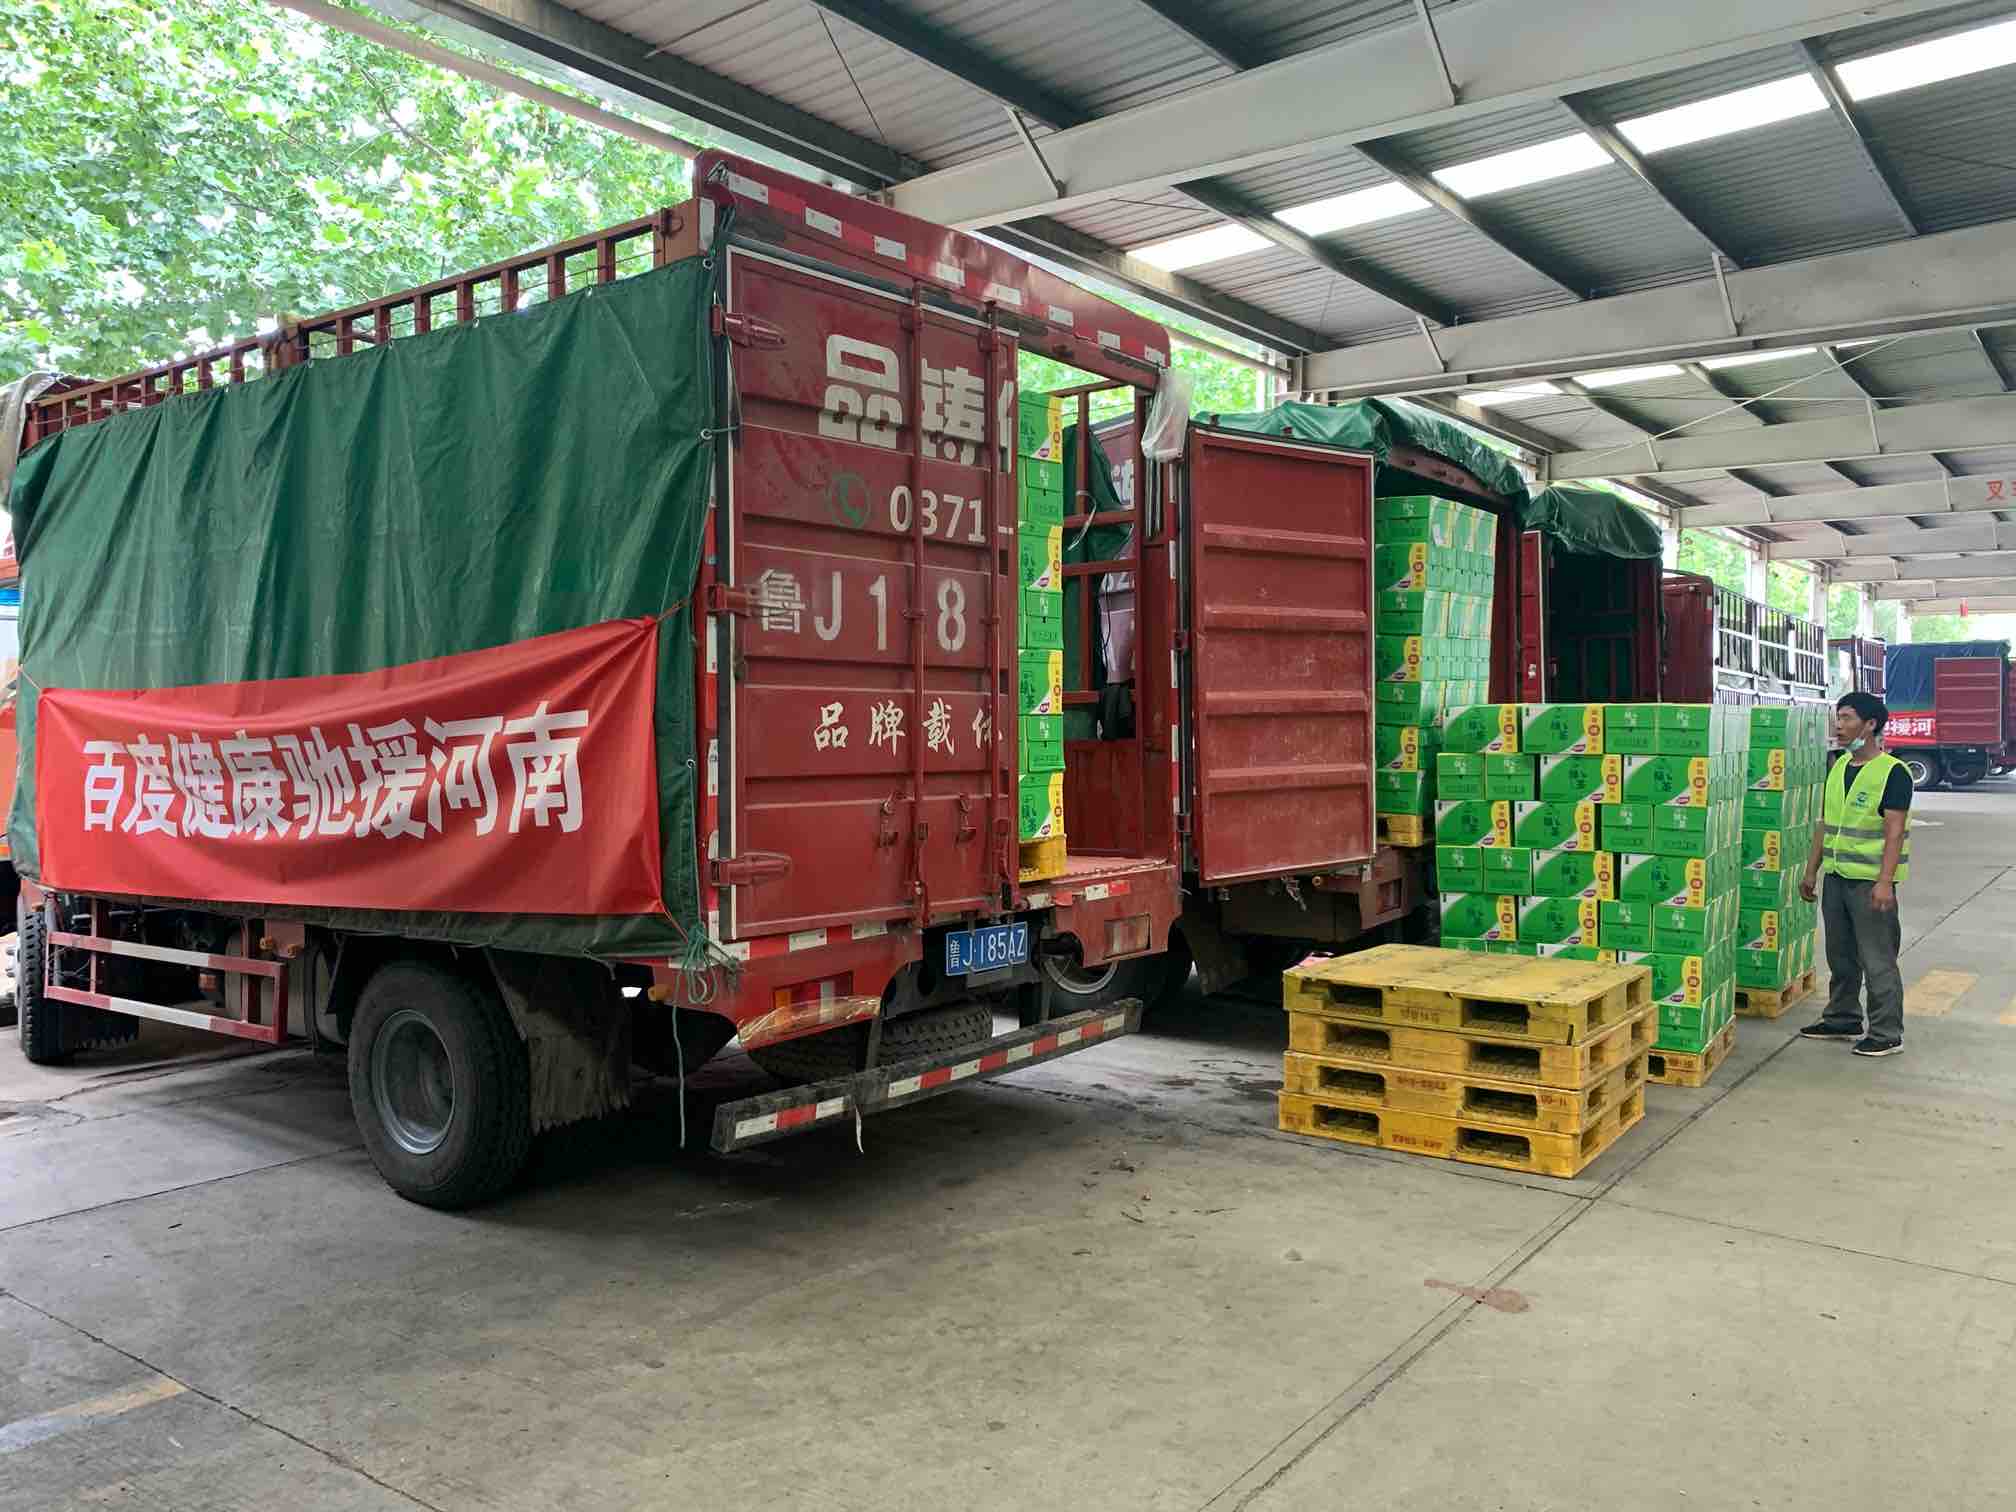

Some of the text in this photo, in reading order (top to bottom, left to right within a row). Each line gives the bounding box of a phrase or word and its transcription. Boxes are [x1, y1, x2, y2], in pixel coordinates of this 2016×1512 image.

[83, 700, 589, 841] 百度健康驰援河南
